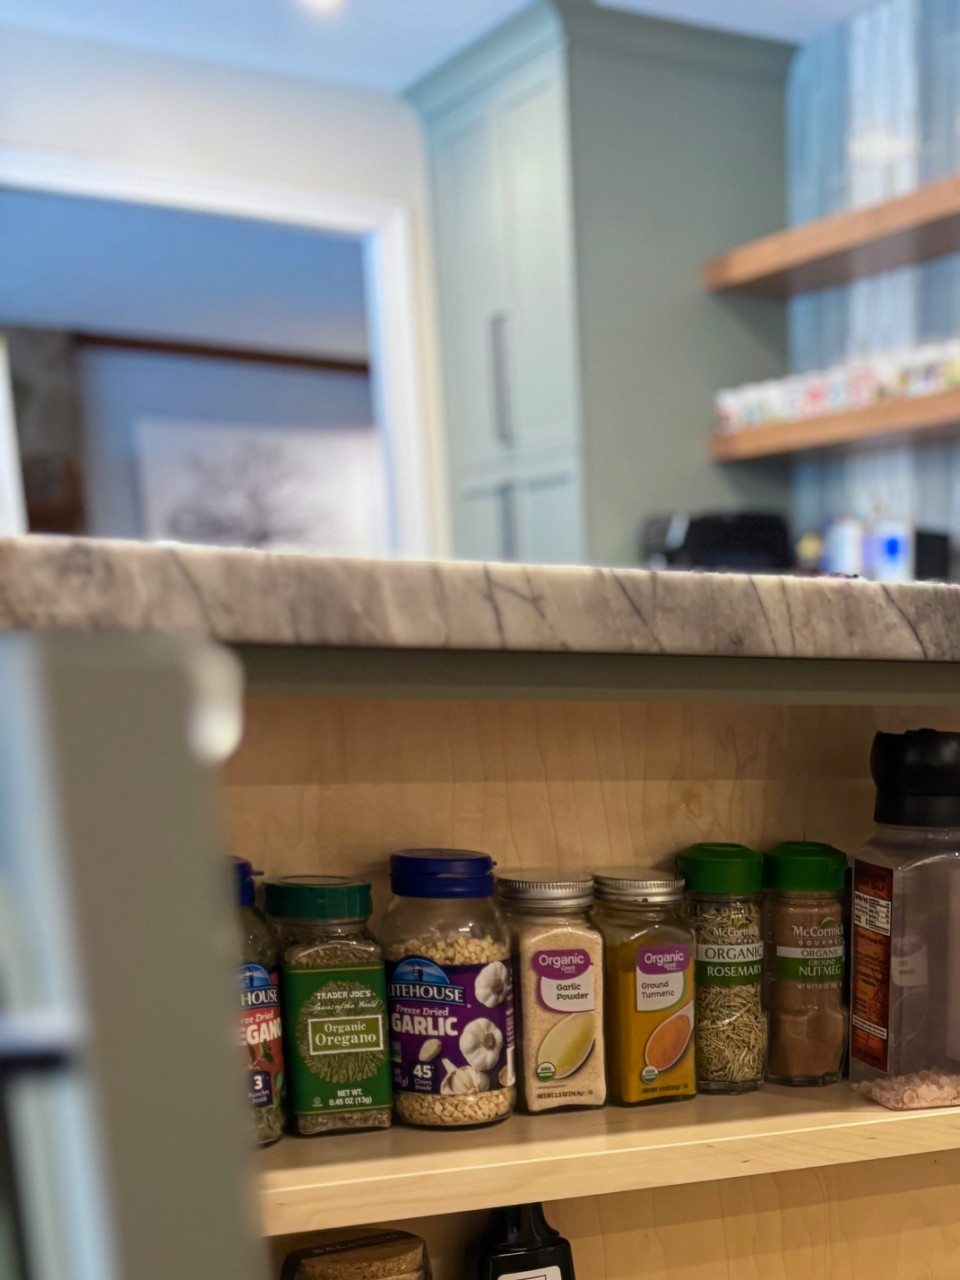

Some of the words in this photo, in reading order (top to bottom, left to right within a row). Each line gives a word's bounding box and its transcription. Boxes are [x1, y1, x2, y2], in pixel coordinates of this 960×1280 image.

[538, 952, 585, 969] Organic
[644, 950, 685, 966] Organic
[799, 965, 841, 977] NUTMEG
[556, 983, 582, 992] Garlic
[641, 980, 669, 990] Ground
[316, 990, 348, 1000] TRADER
[349, 989, 371, 999] JOE'S
[556, 991, 589, 1001] Powder
[641, 989, 675, 999] Turmeric
[395, 1004, 421, 1015] Freeze
[422, 1006, 449, 1017] Dried
[324, 1021, 367, 1034] Organic
[391, 1013, 459, 1036] GARLIC
[315, 1033, 377, 1046] Oregano
[413, 1064, 432, 1078] 45
